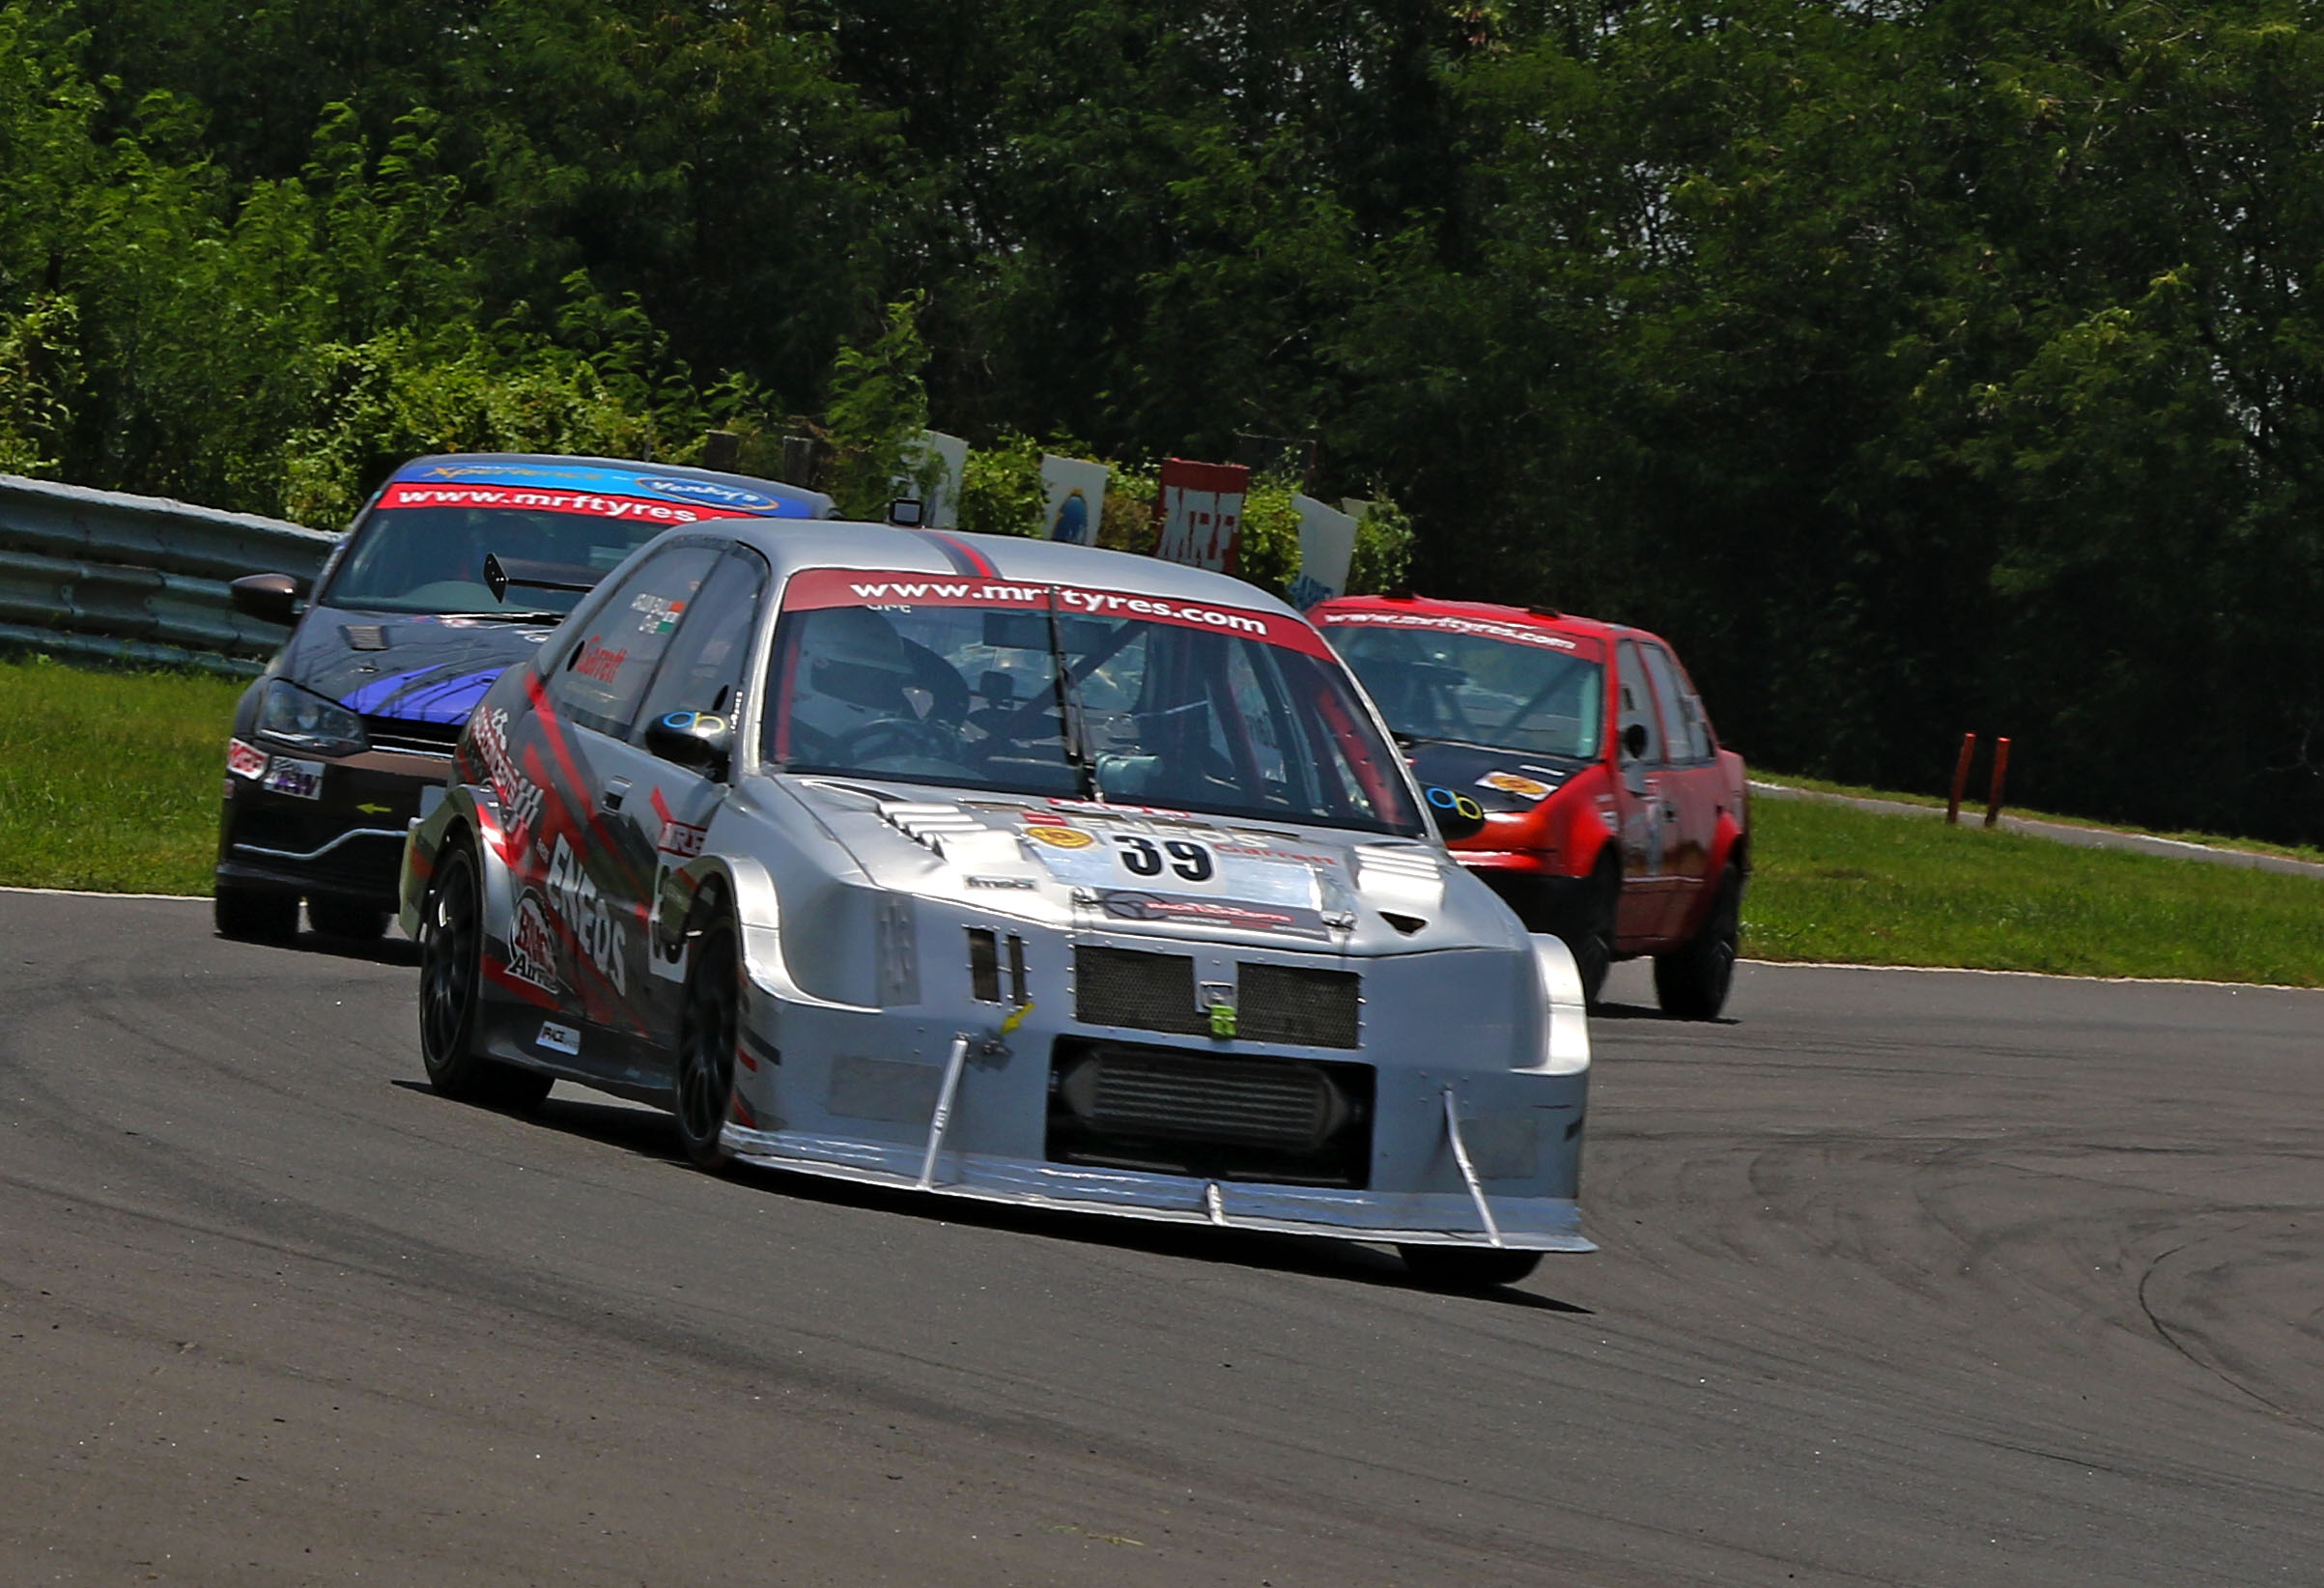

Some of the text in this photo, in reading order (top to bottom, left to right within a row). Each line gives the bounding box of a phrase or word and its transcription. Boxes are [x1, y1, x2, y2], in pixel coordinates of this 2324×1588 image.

[398, 490, 723, 523] www.mrftyres
[1156, 485, 1245, 572] MRF
[1324, 613, 1576, 650] www.mrftyres.com
[1113, 835, 1213, 883] 39
[1213, 843, 1339, 866] Garrett
[546, 832, 627, 997] ENEOS
